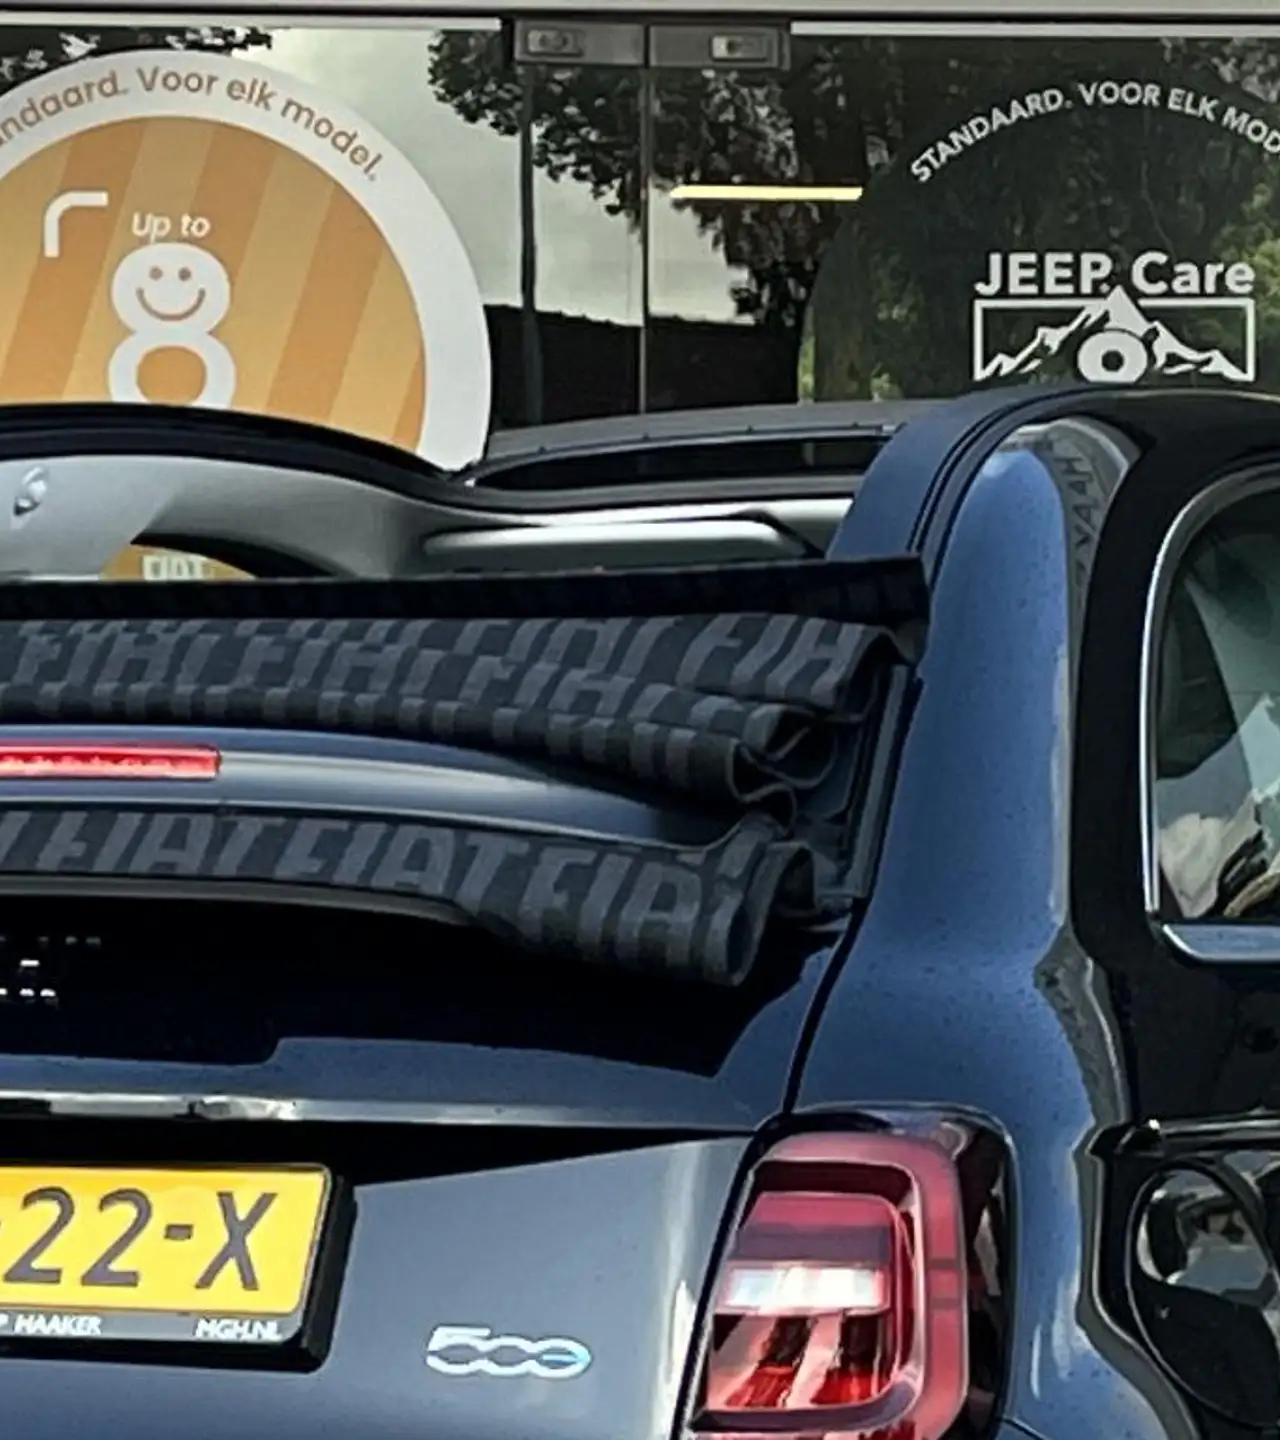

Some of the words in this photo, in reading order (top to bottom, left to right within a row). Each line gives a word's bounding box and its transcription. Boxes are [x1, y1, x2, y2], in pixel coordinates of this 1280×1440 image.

[1077, 81, 1162, 106] VOOR
[1168, 88, 1219, 123] ELK
[136, 67, 220, 97] Voor
[226, 78, 279, 111] elk
[279, 98, 384, 182] model.
[133, 213, 171, 240] Up
[180, 213, 212, 238] to
[1131, 251, 1256, 295] Care
[14, 1313, 102, 1336] HAAKER
[426, 1326, 591, 1378] 500
